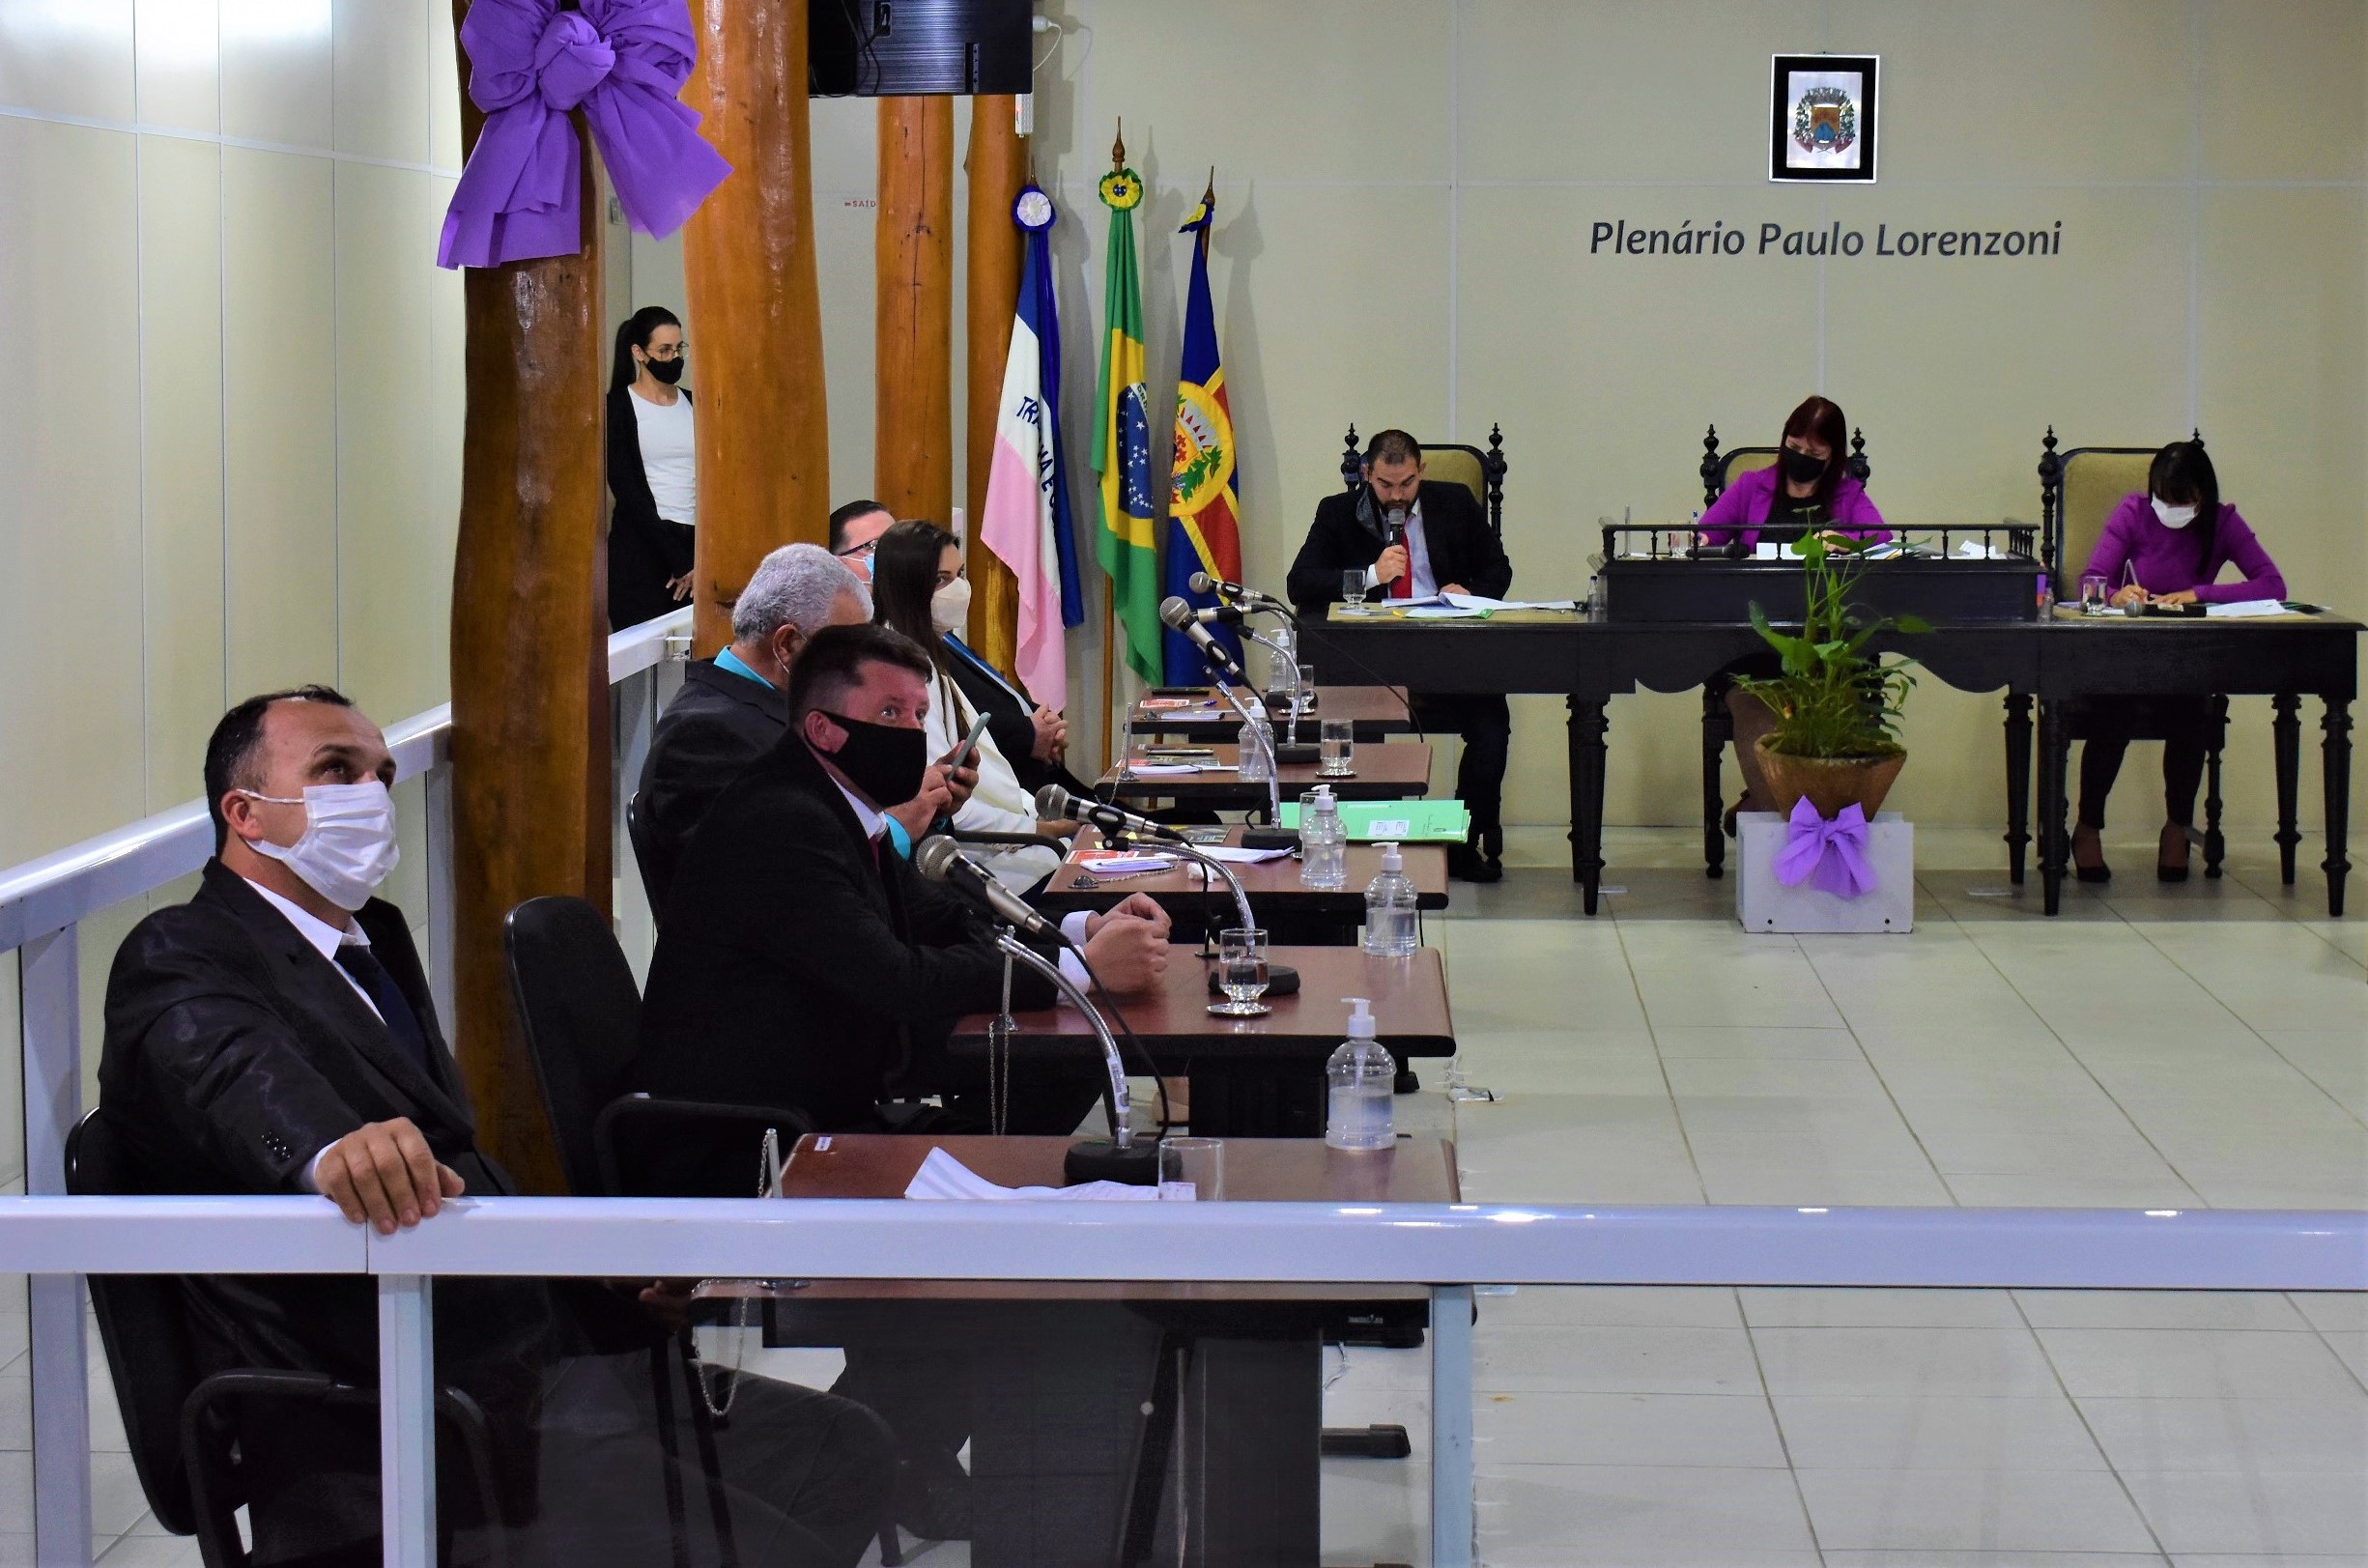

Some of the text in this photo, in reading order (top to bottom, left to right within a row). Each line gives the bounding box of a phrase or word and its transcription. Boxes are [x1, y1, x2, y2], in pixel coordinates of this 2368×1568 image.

[853, 199, 876, 208] SAÍD
[1590, 219, 2062, 256] Plenário Paulo Lorenzoni
